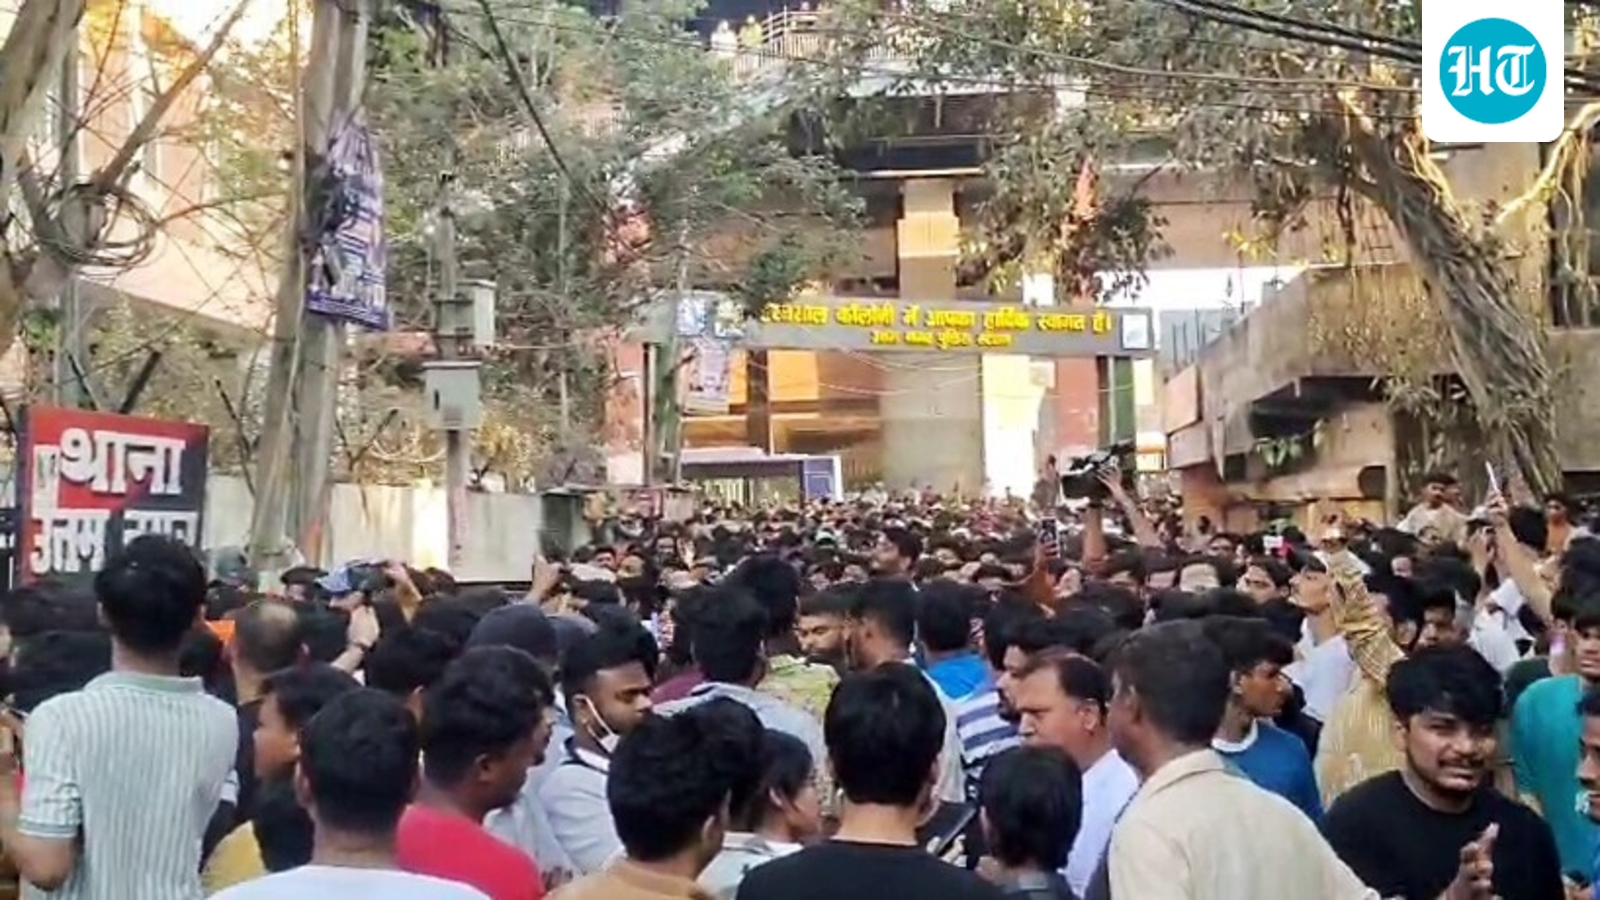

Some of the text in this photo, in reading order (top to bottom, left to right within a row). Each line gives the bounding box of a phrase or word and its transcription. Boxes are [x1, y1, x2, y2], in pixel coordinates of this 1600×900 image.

[925, 309, 975, 328] आपका
[984, 306, 1030, 331] हार्दिक
[1037, 312, 1085, 331] स्वागत
[60, 427, 186, 495] थाना
